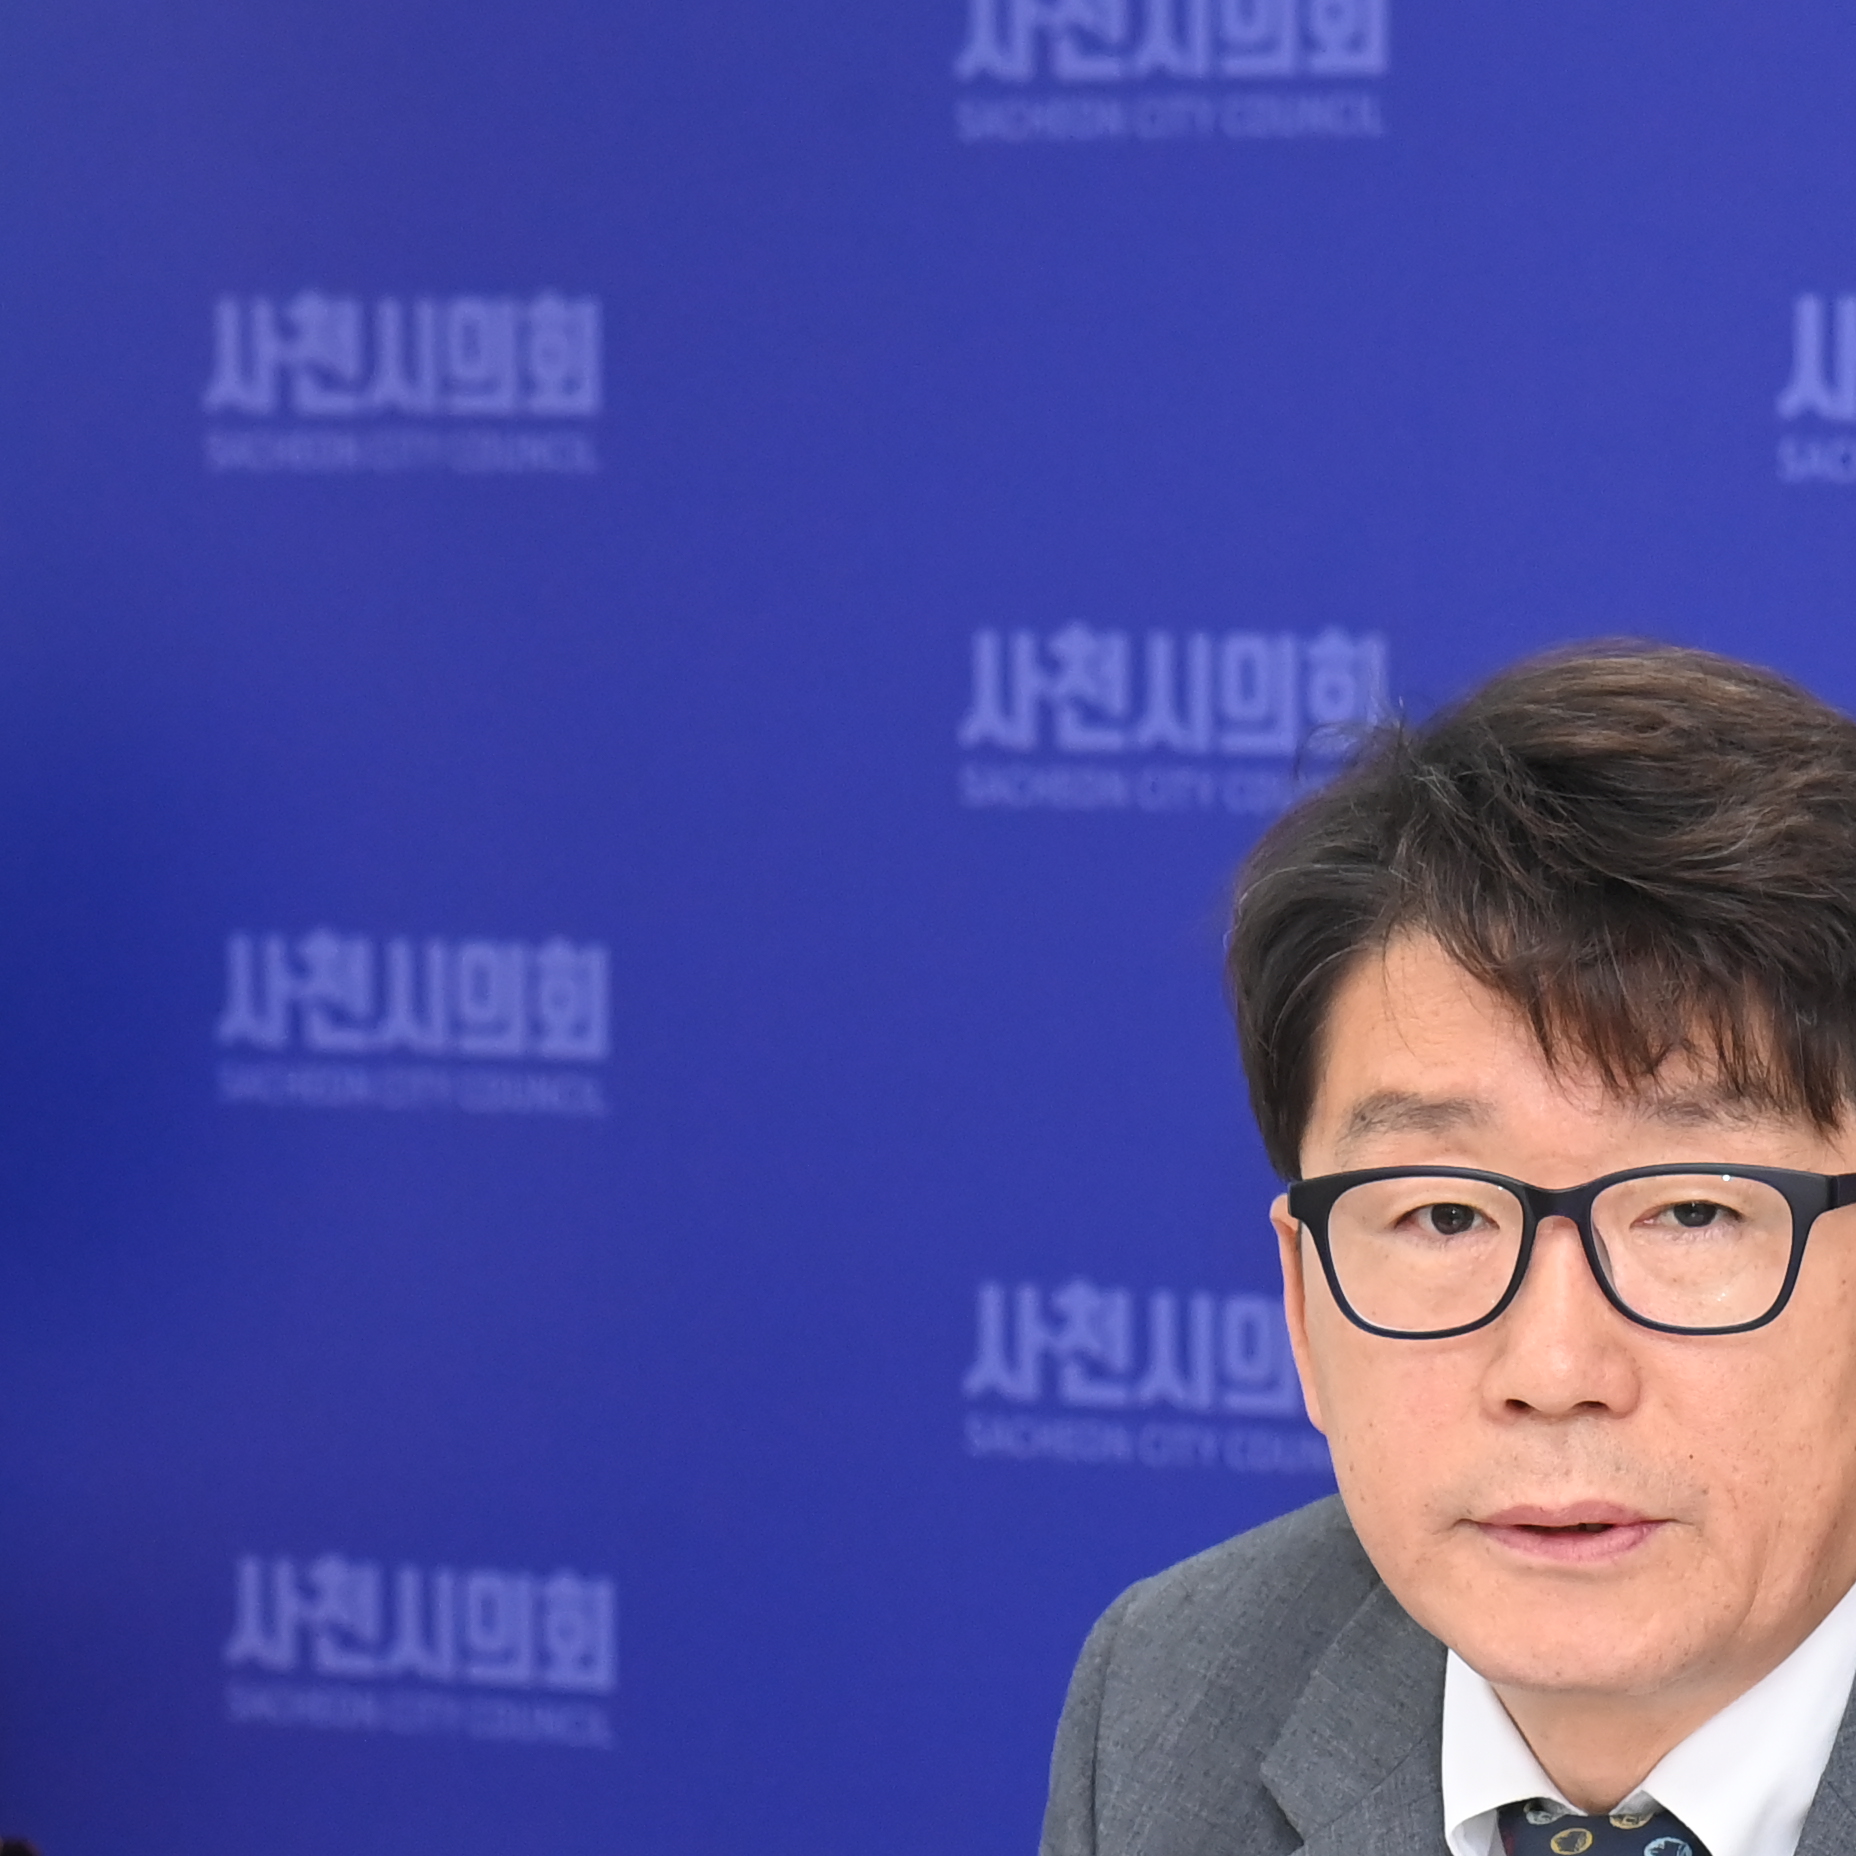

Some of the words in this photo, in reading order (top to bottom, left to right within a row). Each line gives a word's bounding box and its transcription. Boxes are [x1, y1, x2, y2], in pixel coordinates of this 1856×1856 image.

[203, 290, 601, 415] 사천시의회
[220, 928, 610, 1060] 사천시의회
[964, 1279, 1302, 1417] 사천시의
[227, 1555, 615, 1693] 사천시의회
